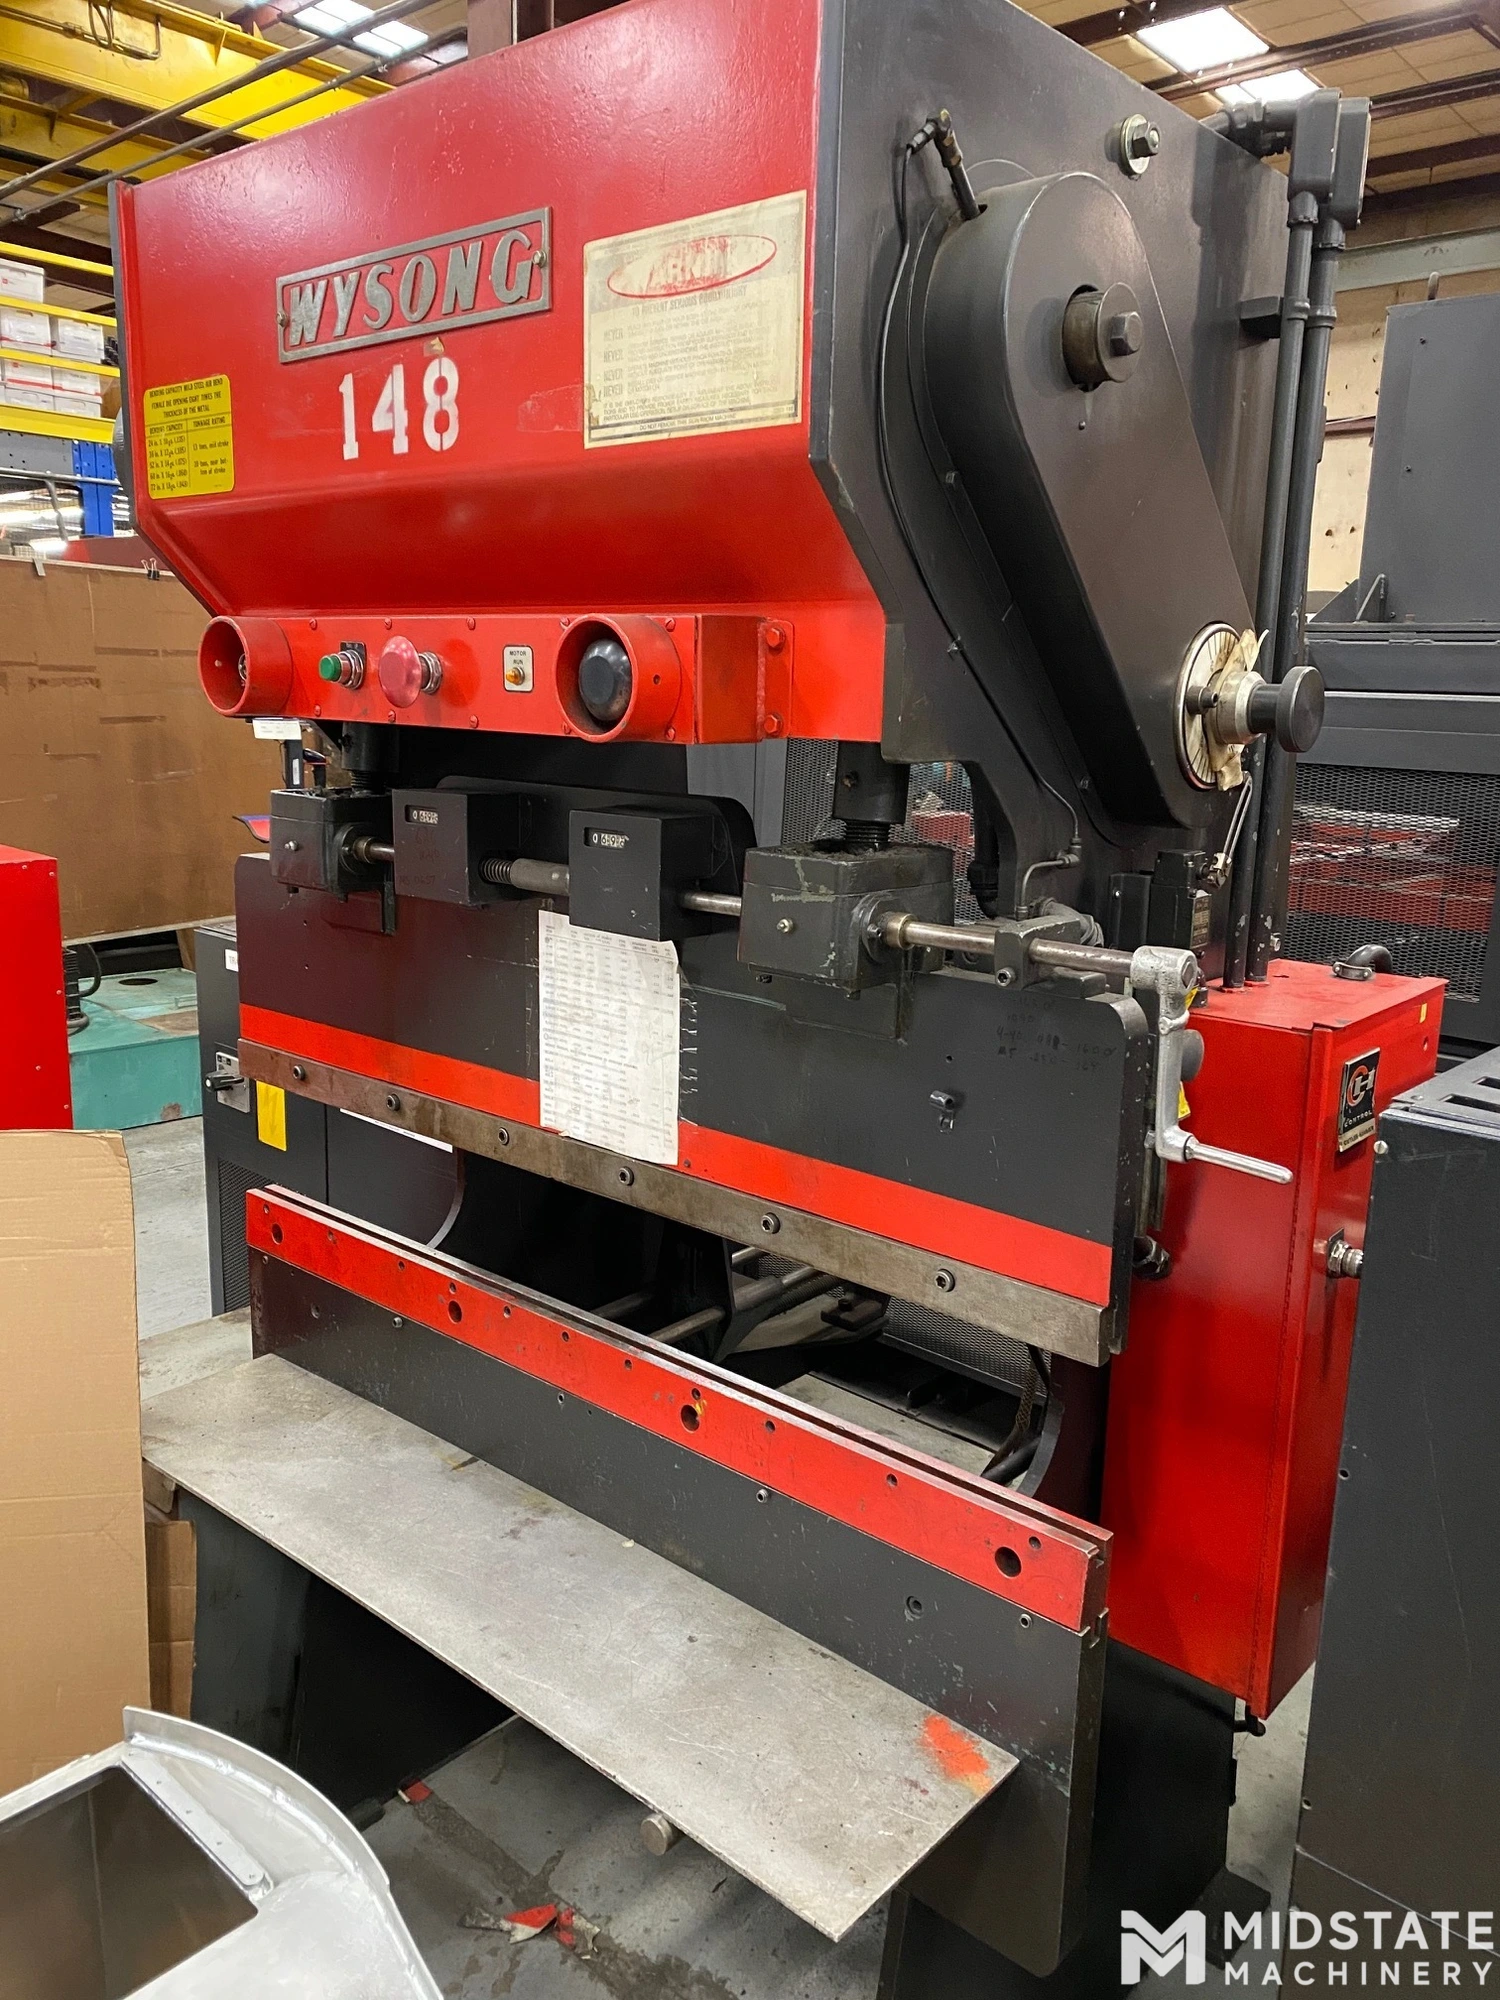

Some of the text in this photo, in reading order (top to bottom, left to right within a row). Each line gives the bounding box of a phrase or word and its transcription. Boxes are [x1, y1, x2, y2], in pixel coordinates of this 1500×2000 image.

[289, 230, 532, 347] WYSONG
[338, 356, 459, 461] 148
[1344, 1110, 1372, 1128] CONTROL
